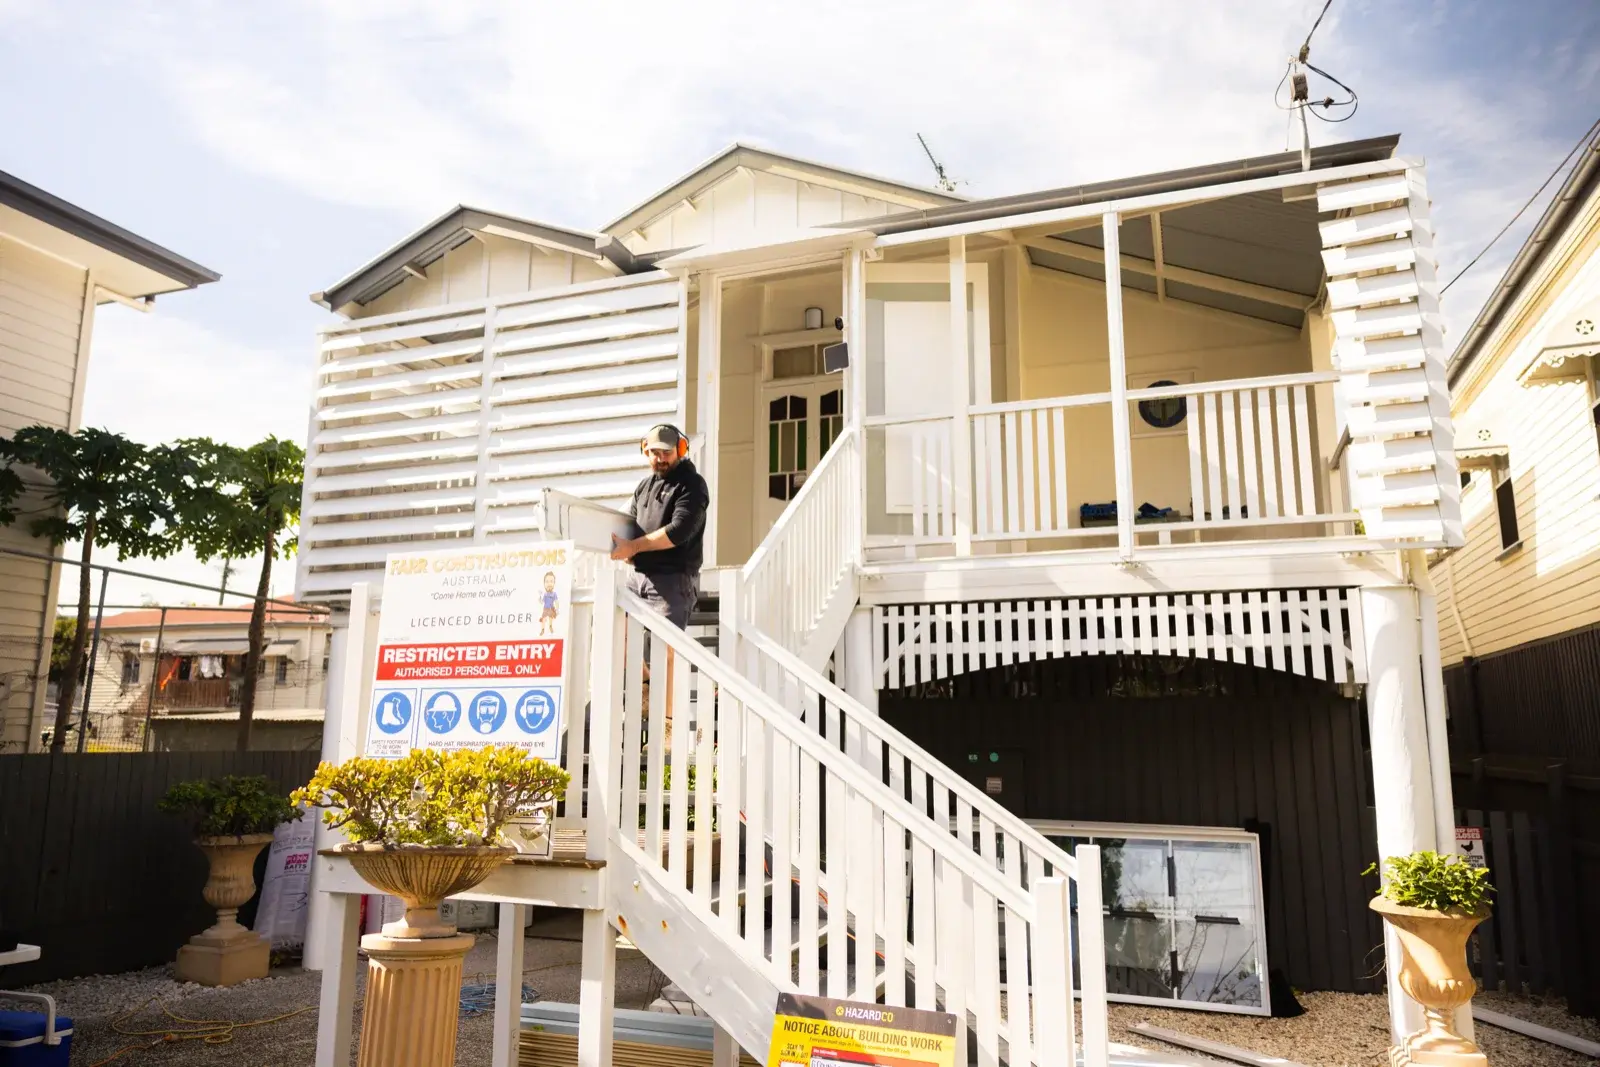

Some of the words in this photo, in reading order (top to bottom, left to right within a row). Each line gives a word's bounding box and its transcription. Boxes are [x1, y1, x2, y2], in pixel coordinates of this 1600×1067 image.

[390, 558, 428, 575] FARR
[432, 549, 567, 573] CONSTRUCTIONS
[442, 574, 507, 587] AUSTRALIA
[455, 591, 477, 600] Home
[478, 590, 486, 599] to
[410, 616, 472, 628] LICENCED
[477, 613, 533, 625] BUILDER
[383, 645, 489, 664] RESTRICTED
[495, 643, 556, 661] ENTRY
[394, 667, 452, 677] AUTHORISED
[455, 665, 512, 676] PERSONNEL
[515, 664, 542, 675] ONLY
[845, 1006, 894, 1023] HAZARDCO
[784, 1020, 820, 1035] NOTICE
[822, 1025, 857, 1040] ABOUT
[859, 1029, 908, 1047] BUILDING
[911, 1036, 942, 1051] WORK
